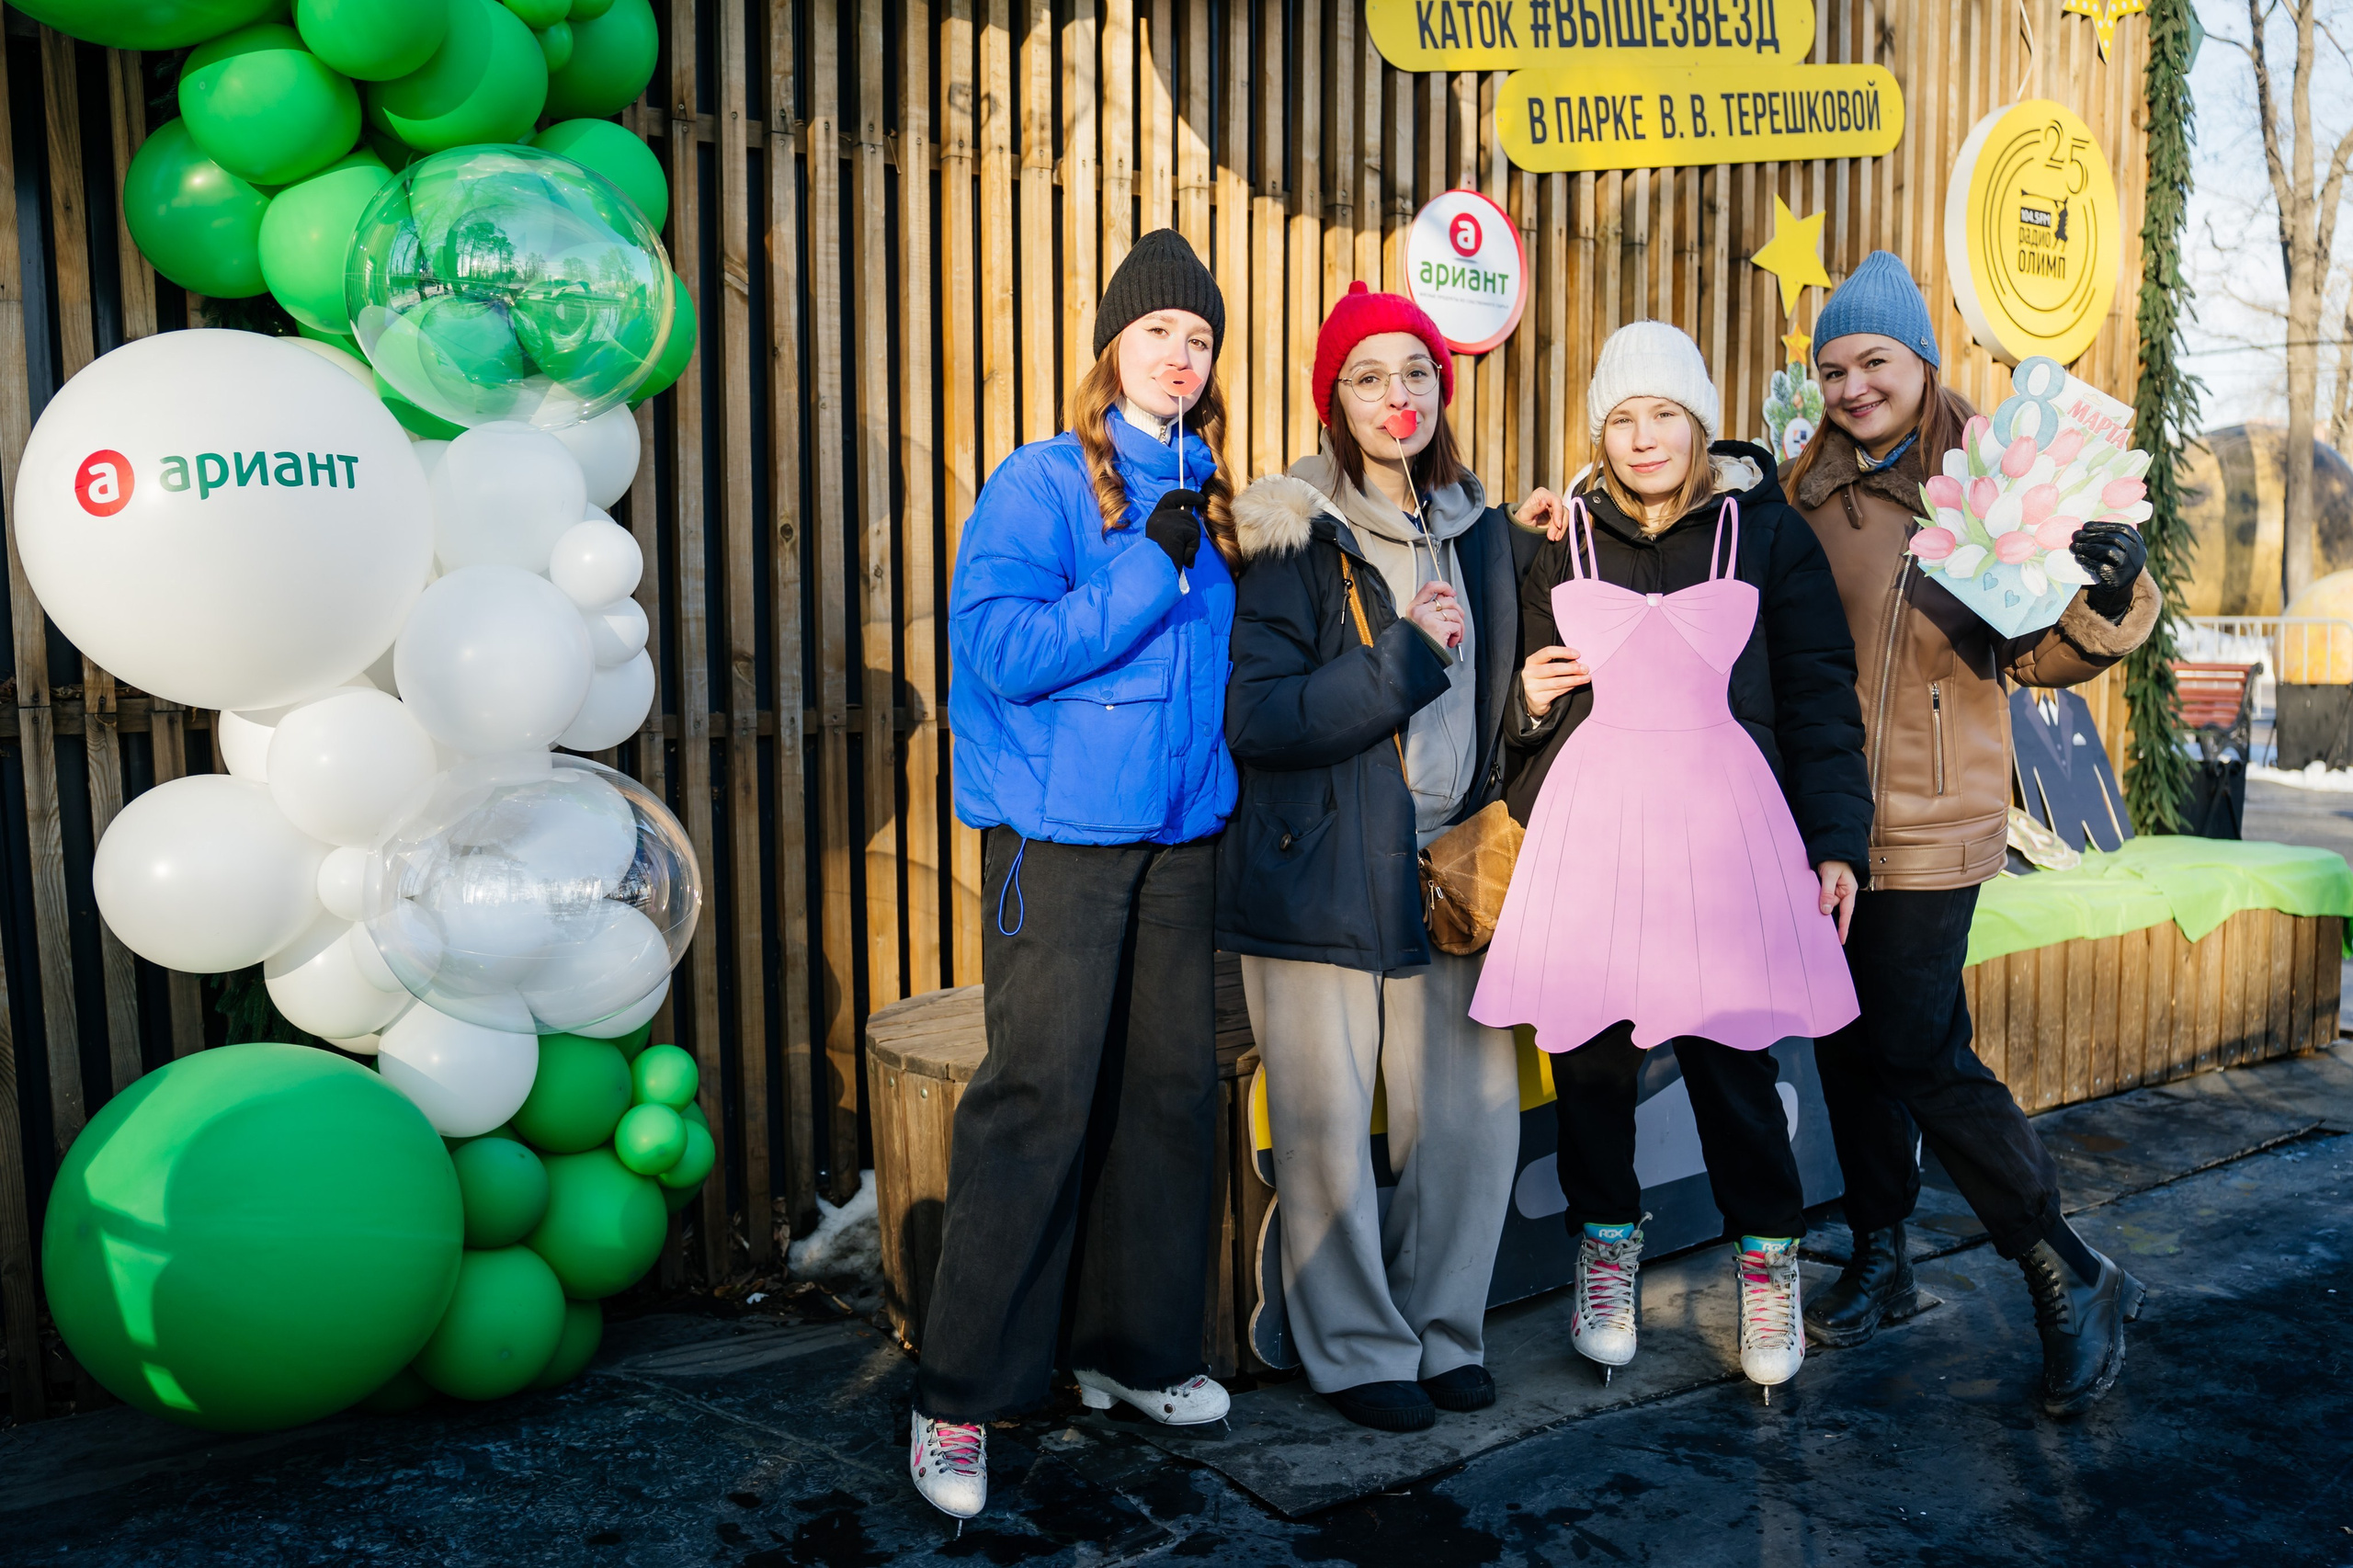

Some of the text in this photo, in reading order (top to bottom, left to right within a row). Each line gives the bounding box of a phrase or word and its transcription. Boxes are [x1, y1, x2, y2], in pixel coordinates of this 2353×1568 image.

[1415, 0, 1780, 54] КАТОК #ВЫШЕЗВЕЗД
[1528, 79, 1881, 145] В ПАРКЕ В. В. ТЕРЕШКОВОЙ
[2043, 119, 2090, 195] 25
[2018, 226, 2052, 250] радио
[2018, 249, 2066, 279] ОЛИМП
[1419, 260, 1509, 295] ариант
[1993, 356, 2130, 453] 8 МАРТА
[159, 450, 359, 500] ариант
